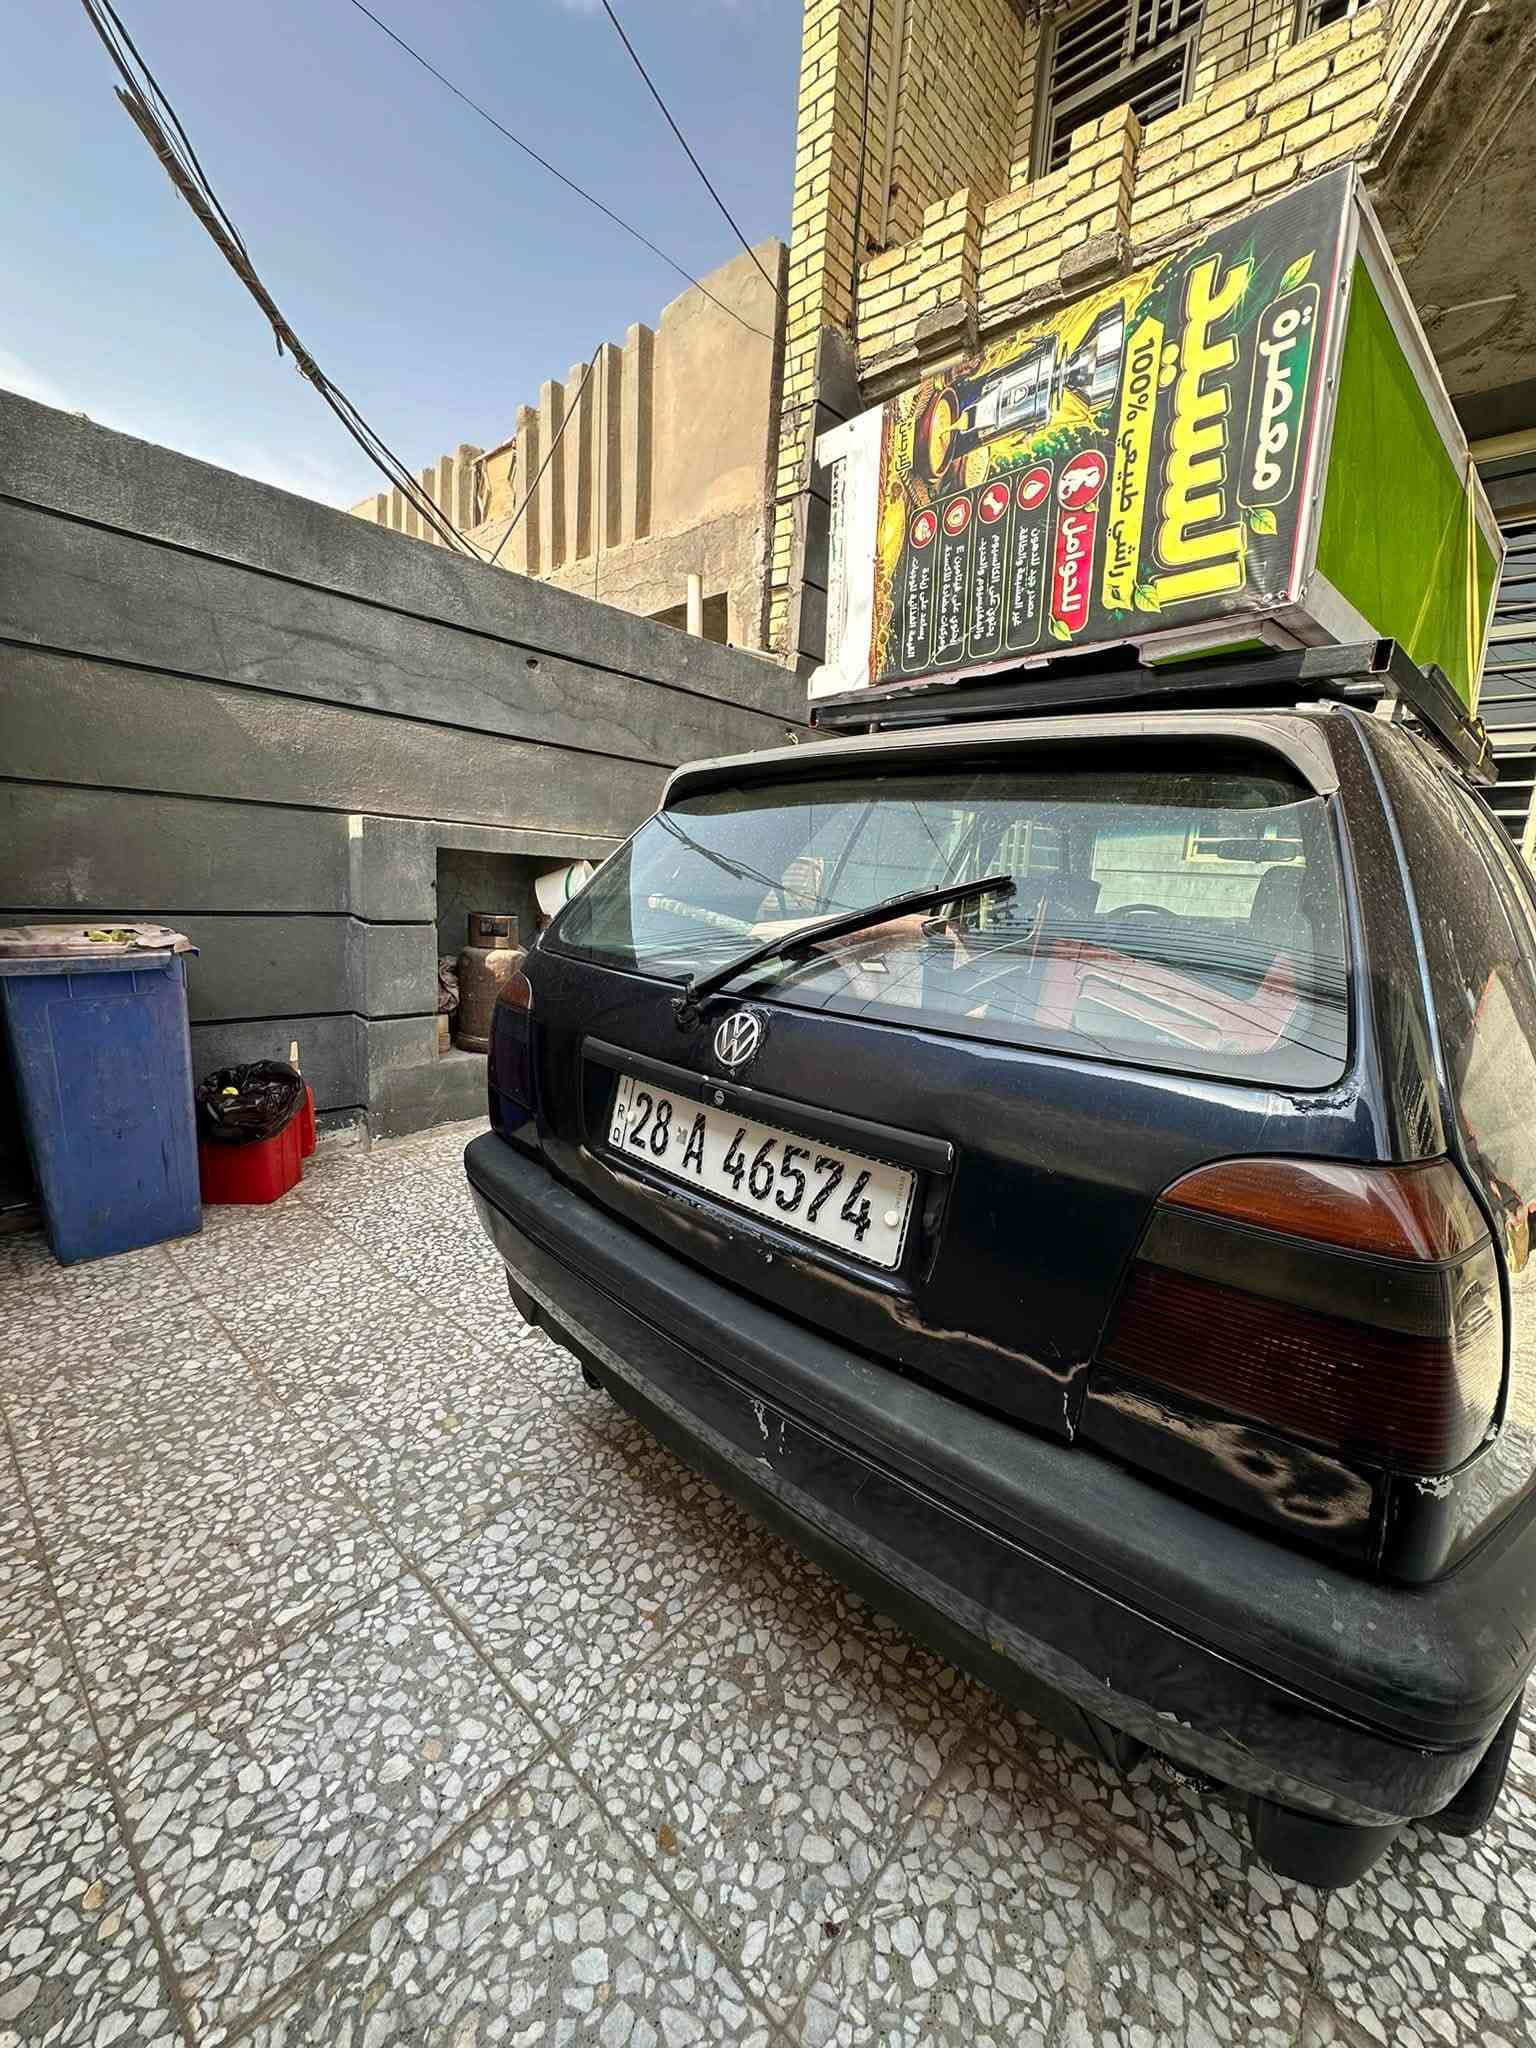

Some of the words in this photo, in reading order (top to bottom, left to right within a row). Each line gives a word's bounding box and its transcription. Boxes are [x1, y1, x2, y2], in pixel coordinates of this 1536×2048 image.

[1126, 336, 1154, 421] 100%
[1252, 305, 1312, 490] معصرة
[1151, 261, 1248, 606] السيد
[1115, 428, 1138, 512] طبيعي
[955, 545, 965, 553] E
[989, 534, 1001, 583] الكالسيوم
[1058, 516, 1087, 611] للحوامل
[1107, 519, 1135, 577] راشي
[918, 567, 930, 589] زيادة
[1012, 566, 1028, 608] المشبعة
[1026, 569, 1037, 587] جيد
[916, 591, 929, 610] على
[950, 594, 962, 613] على
[987, 585, 998, 605] على
[1025, 589, 1036, 618] مصدر
[916, 612, 927, 640] يساعد
[983, 606, 998, 637] يحتوي
[1010, 611, 1021, 626] غير
[905, 629, 917, 657] القيمة
[714, 1012, 758, 1066] VW
[629, 1092, 673, 1157] 28
[681, 1112, 706, 1174] A
[722, 1127, 872, 1241] 46574
